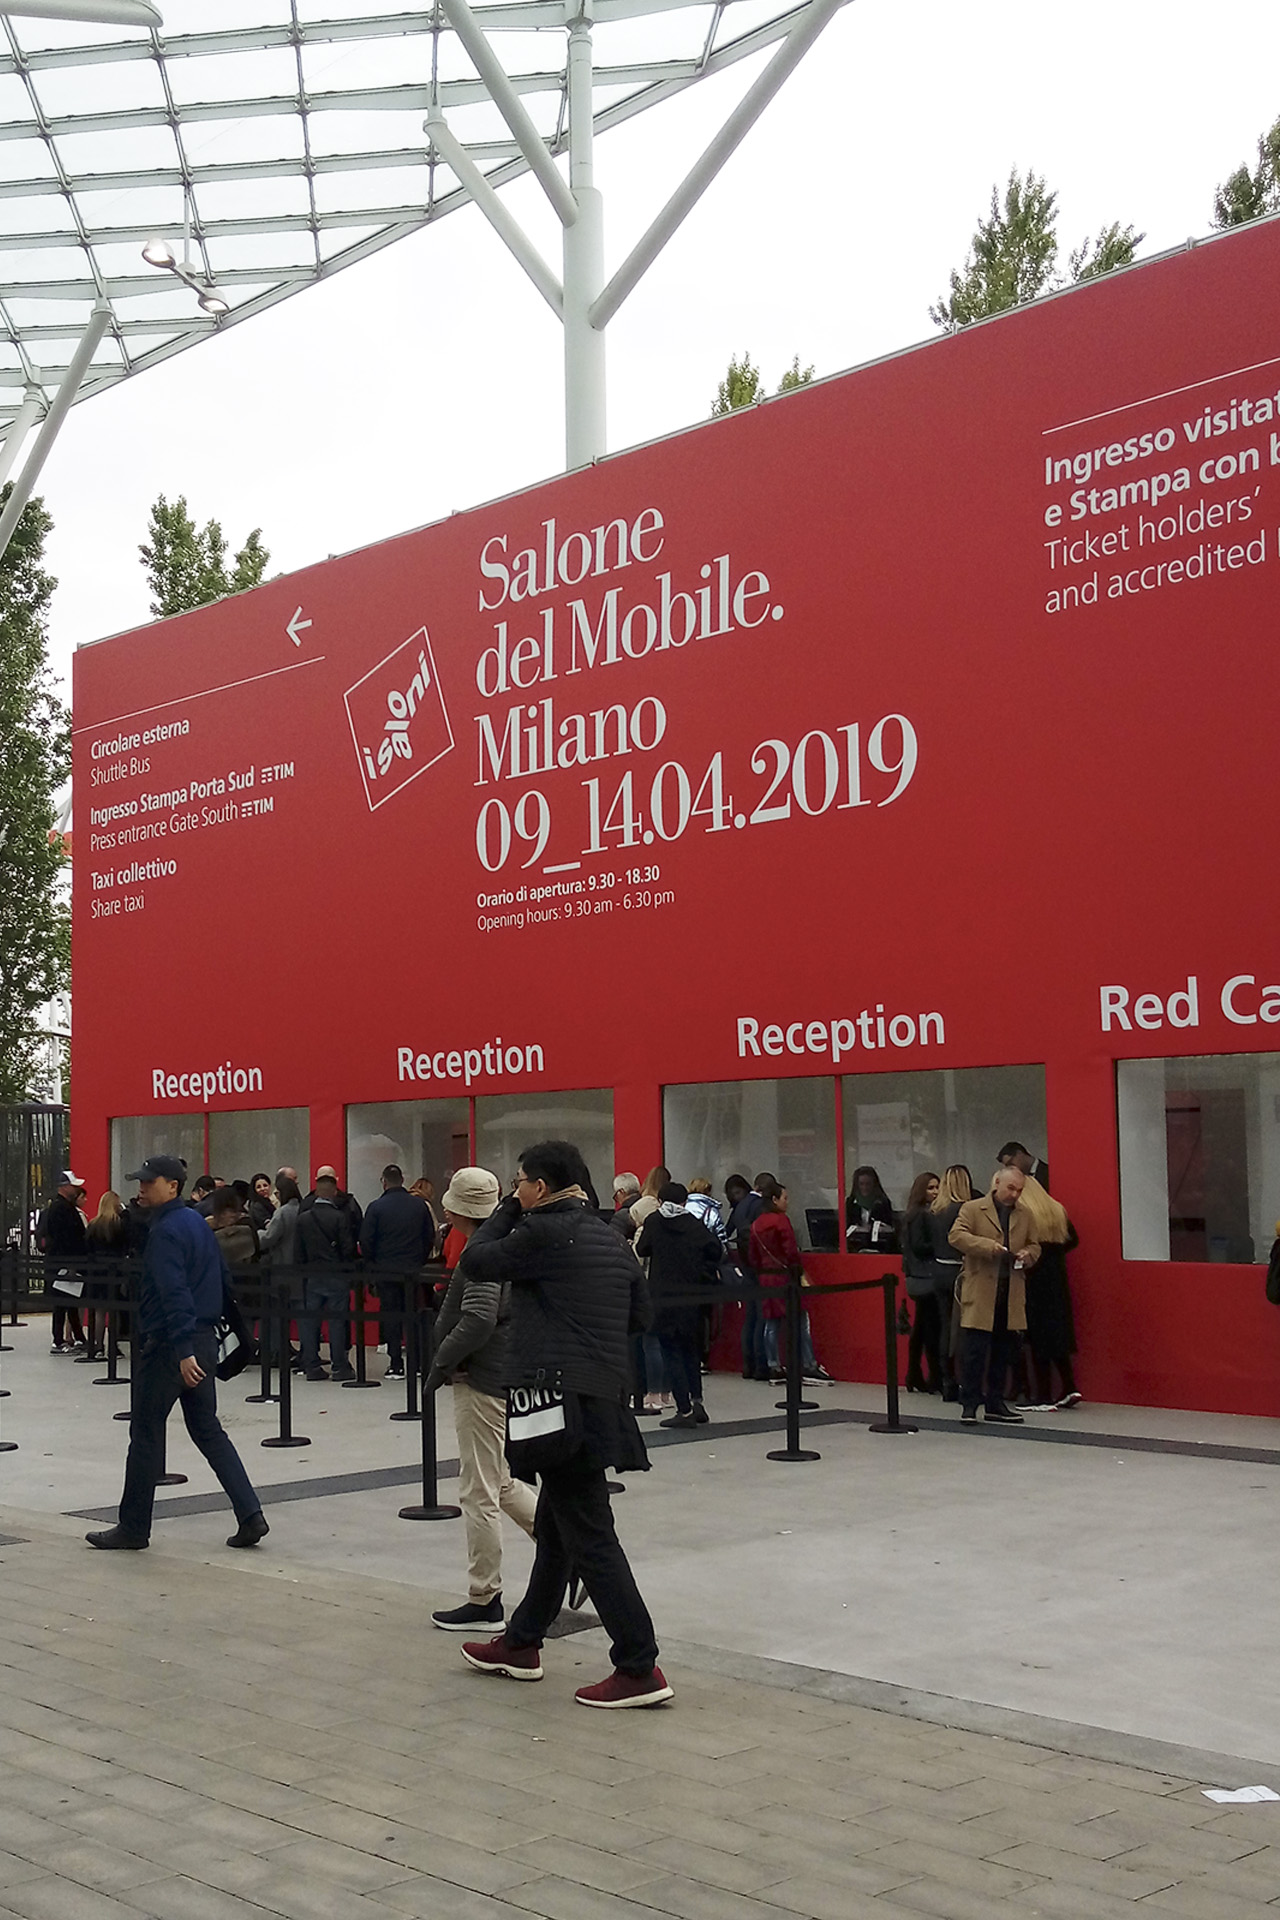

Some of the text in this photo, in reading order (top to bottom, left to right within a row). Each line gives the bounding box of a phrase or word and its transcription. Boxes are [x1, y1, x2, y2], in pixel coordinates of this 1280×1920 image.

[1045, 427, 1176, 485] Ingresso
[1044, 502, 1063, 527] e
[1070, 467, 1191, 521] Stampa
[1199, 446, 1260, 484] con
[478, 507, 665, 612] Salone
[1044, 523, 1130, 570] Ticket
[1045, 571, 1098, 614] and
[1107, 529, 1266, 599] accredited
[475, 553, 786, 698] del Mobile.
[91, 719, 190, 760] Circolare esterna
[473, 696, 667, 787] Milano
[90, 757, 151, 787] Shuttle Bus
[90, 761, 295, 828] Ingresso Stampa Porta Sud TIM
[475, 713, 919, 874] 09_14.04.2019
[90, 796, 274, 852] Press entrance Gate South TIM
[90, 857, 177, 890] Taxi collettivo
[476, 889, 514, 908] Orario
[515, 887, 528, 902] di
[529, 879, 586, 903] apertura:
[588, 872, 615, 891] 9.30
[625, 865, 660, 885] 18.30
[90, 890, 145, 919] Share taxi
[477, 911, 524, 933] Opening
[526, 907, 562, 924] hours:
[564, 899, 591, 918] 9.30
[594, 899, 613, 914] am
[623, 890, 651, 910] 6.30
[654, 890, 675, 909] pm
[1100, 976, 1199, 1032] Red
[737, 1003, 946, 1063] Reception
[152, 1060, 263, 1104] Reception
[397, 1036, 545, 1087] Reception
